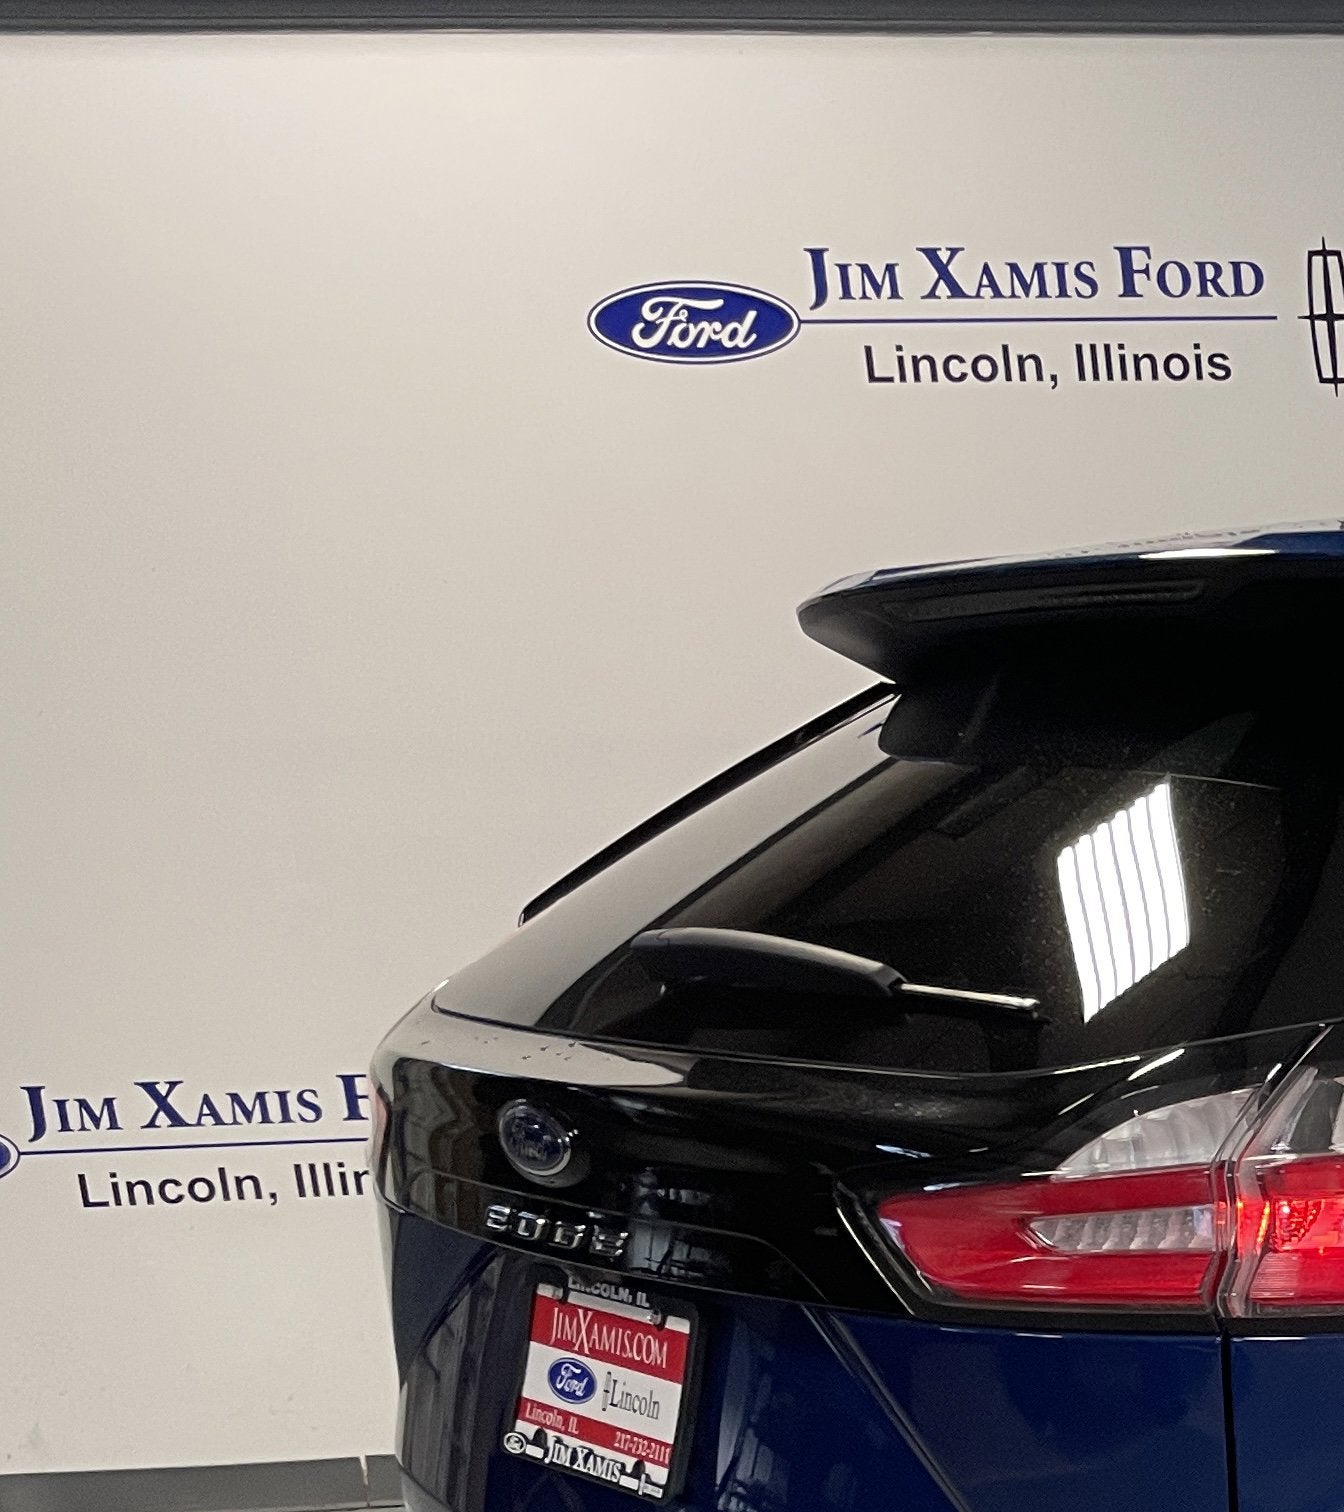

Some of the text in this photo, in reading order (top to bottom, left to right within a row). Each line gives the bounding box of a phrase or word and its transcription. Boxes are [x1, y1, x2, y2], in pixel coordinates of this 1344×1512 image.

[803, 246, 1265, 311] JIM XAMIS FORD
[631, 296, 757, 350] Ford
[864, 343, 1232, 390] Lincoln, Illinois
[19, 1085, 124, 1143] JIM
[133, 1080, 323, 1130] XAMIS
[77, 1166, 278, 1208] Lincoln,
[567, 1276, 633, 1304] LCOLN,
[609, 1379, 660, 1420] Lincoln
